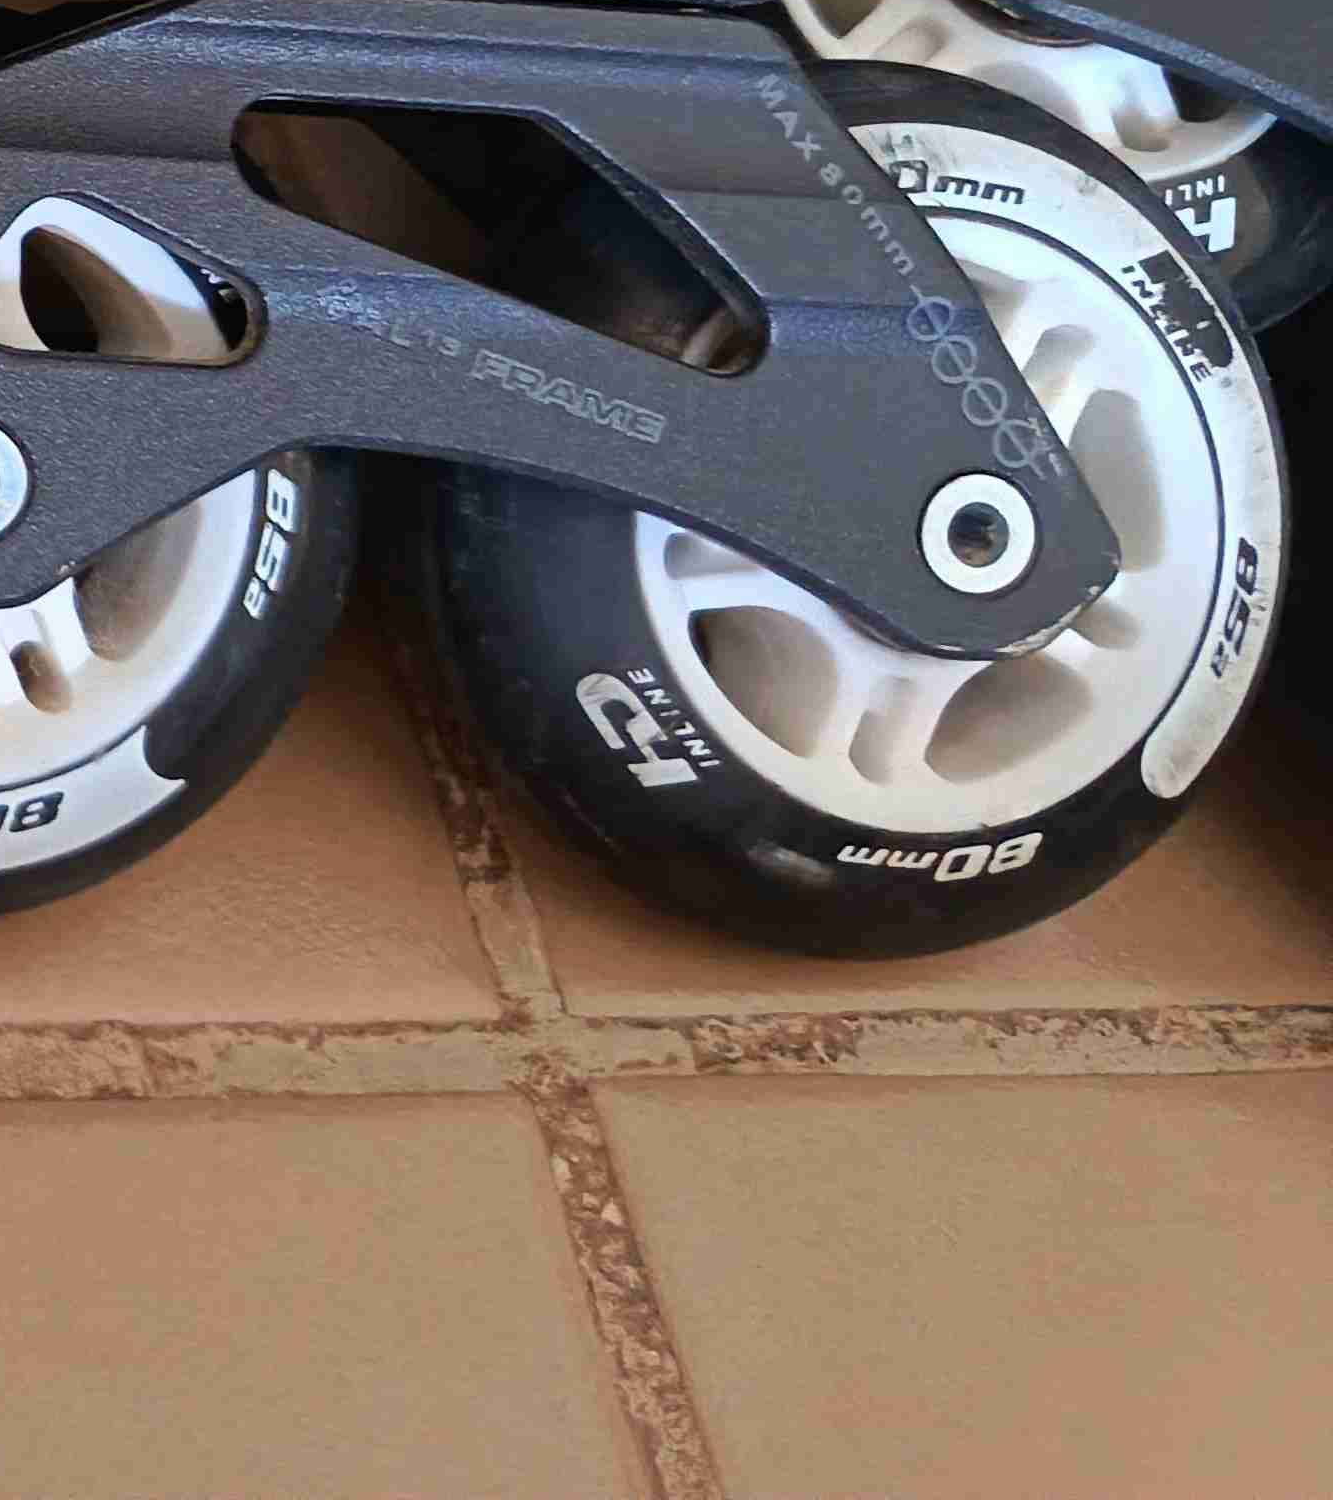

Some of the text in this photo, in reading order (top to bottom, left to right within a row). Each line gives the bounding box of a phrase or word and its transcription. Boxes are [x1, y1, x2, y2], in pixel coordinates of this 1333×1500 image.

[757, 73, 917, 276] MAX 80mm
[889, 158, 1025, 205] 0mm
[1164, 175, 1225, 206] INLI
[1174, 197, 1236, 253] H
[469, 348, 667, 444] FRAME
[242, 468, 300, 622] 85a
[626, 666, 721, 769] INLINE
[837, 831, 1043, 883] 80mm
